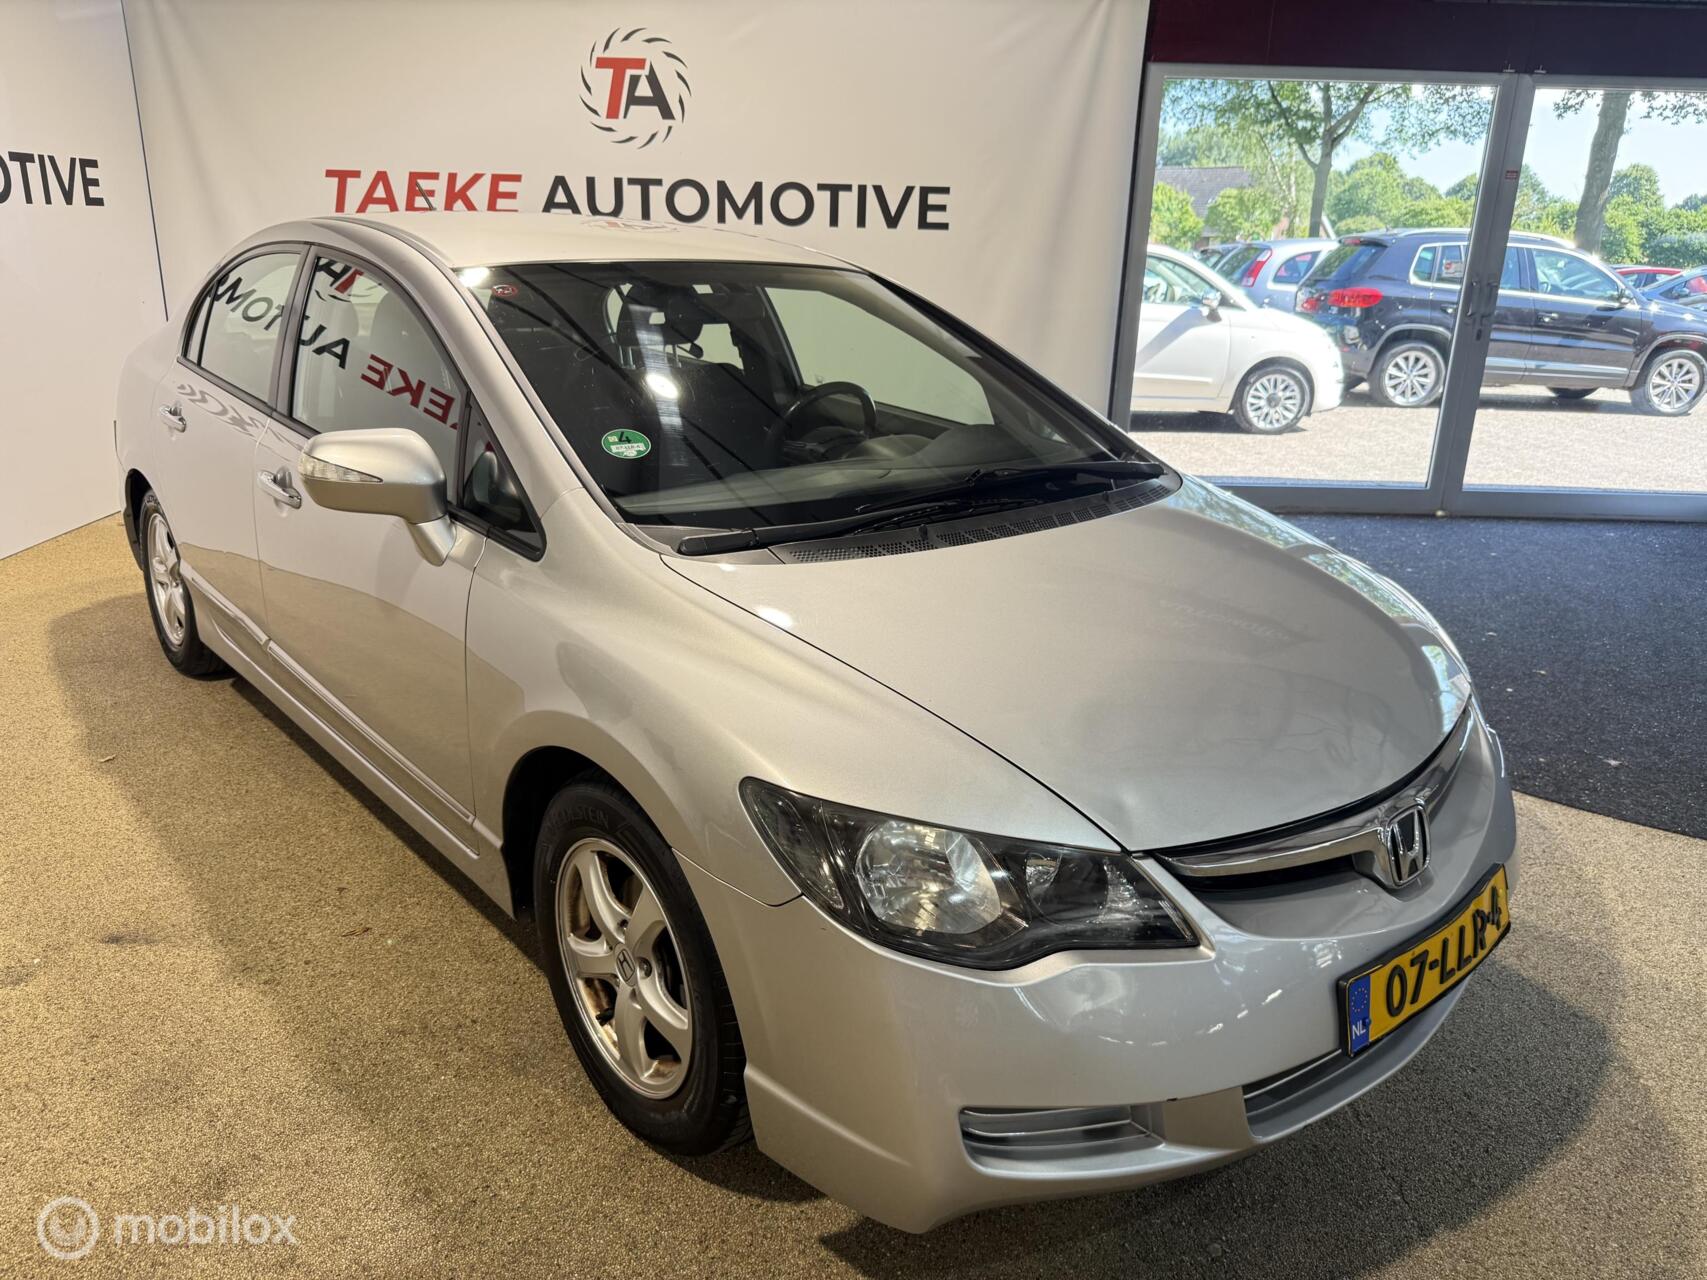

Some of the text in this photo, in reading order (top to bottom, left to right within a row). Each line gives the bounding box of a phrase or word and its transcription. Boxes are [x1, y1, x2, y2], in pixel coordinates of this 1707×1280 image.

[595, 56, 677, 121] TA
[324, 168, 951, 231] TAEKE AUTOMOTIVE
[1385, 885, 1502, 1018] 07-LLR-4
[1352, 1019, 1367, 1040] NL
